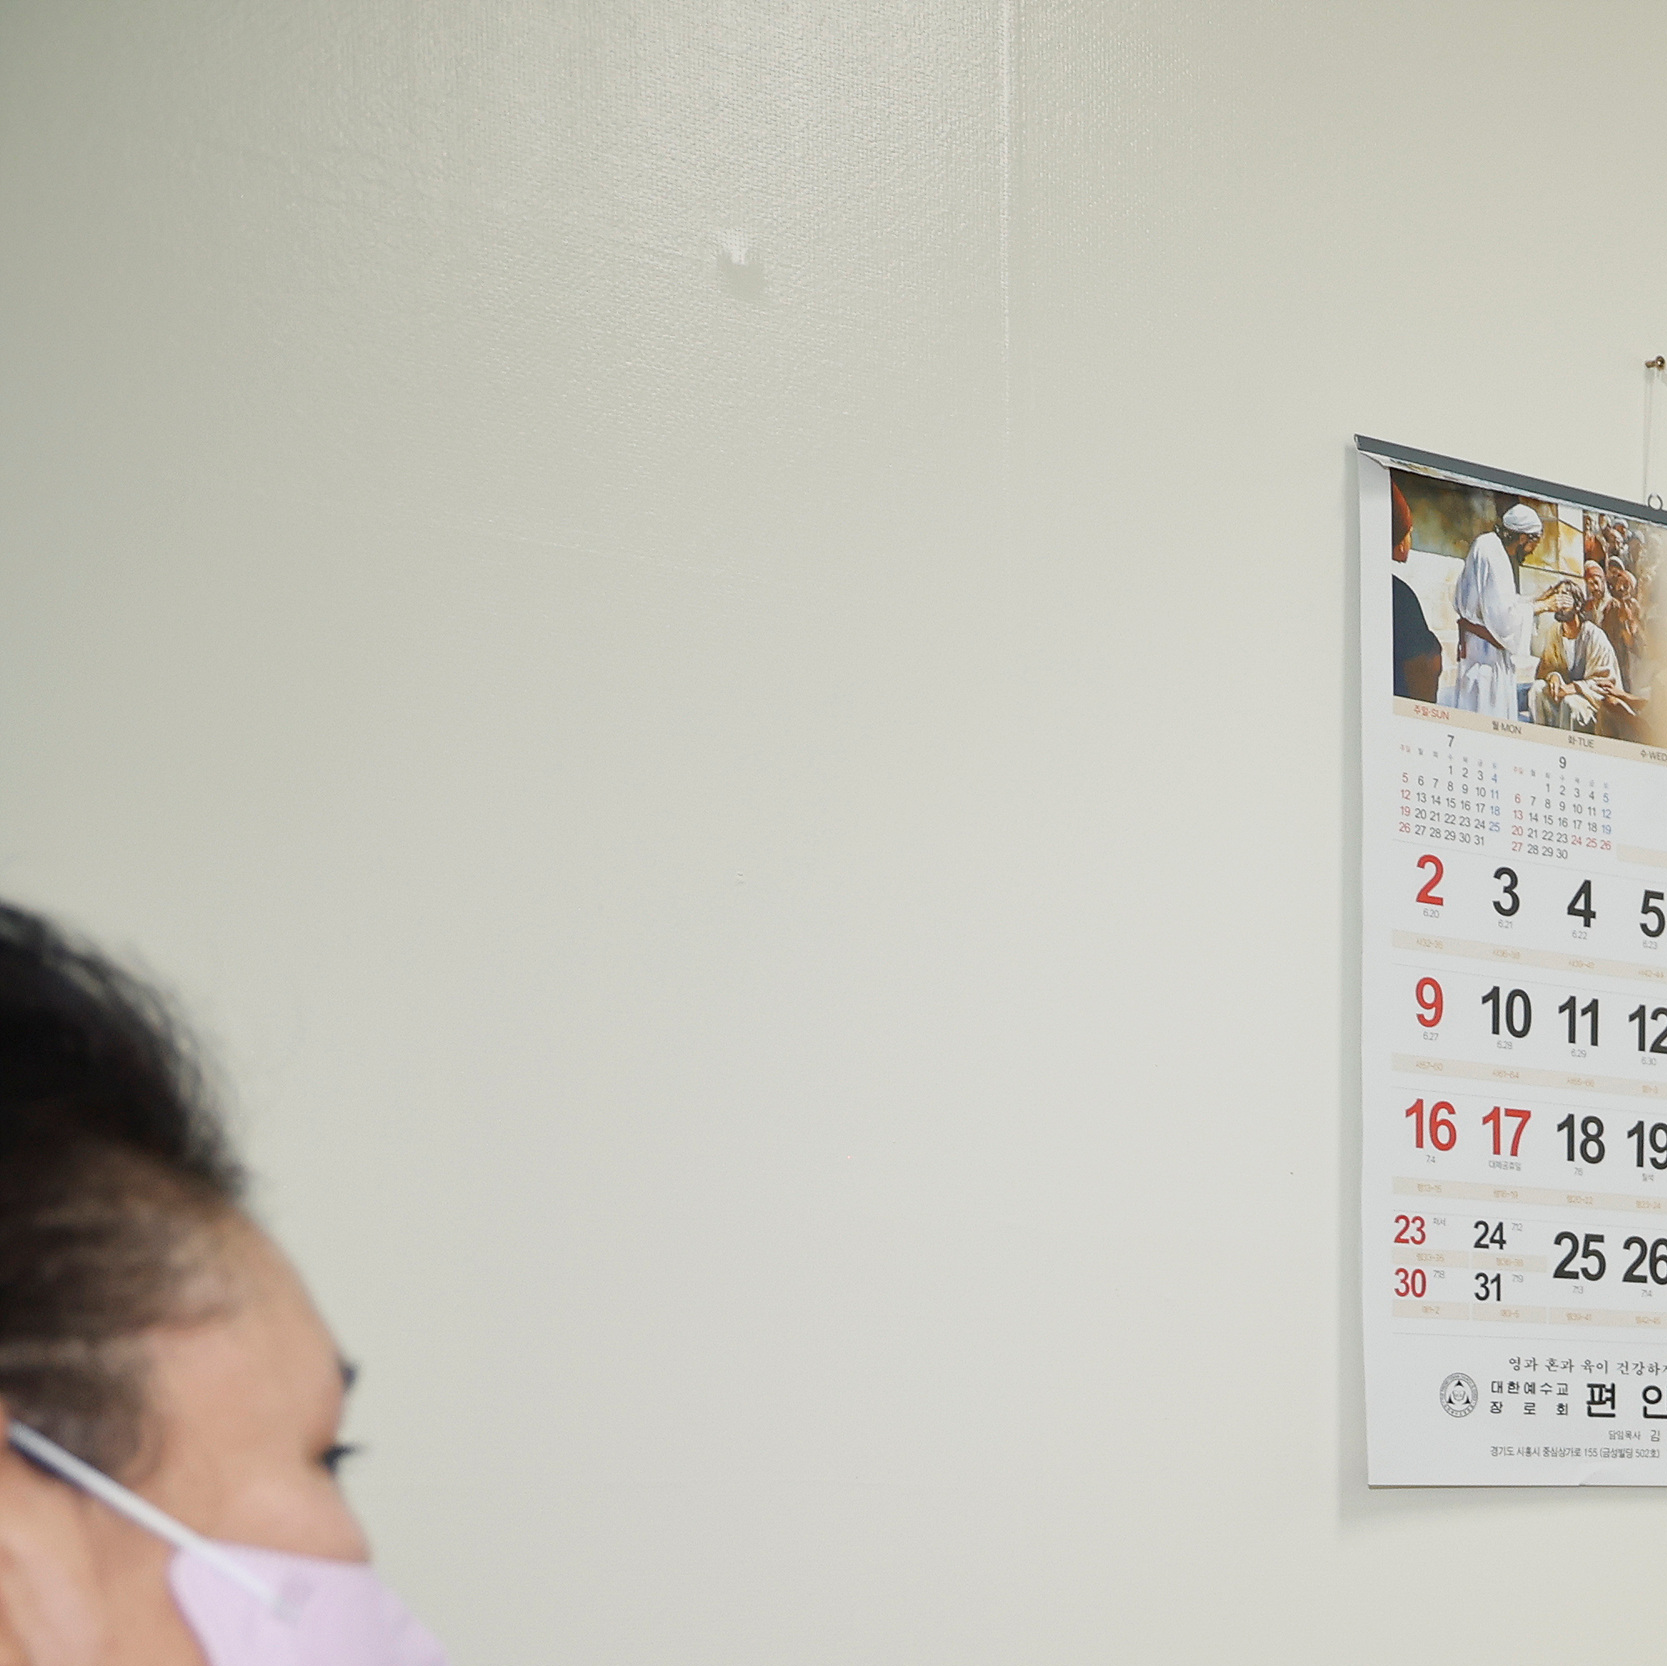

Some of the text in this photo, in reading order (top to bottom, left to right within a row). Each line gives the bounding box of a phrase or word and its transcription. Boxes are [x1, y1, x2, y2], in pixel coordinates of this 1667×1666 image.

[1447, 734, 1455, 748] 7
[1558, 756, 1567, 769] 9
[1400, 788, 1501, 817] 12 13 14 15 16 17 18
[1475, 786, 1487, 798] 10
[1490, 788, 1499, 800] 11
[1399, 805, 1501, 833] 19 20 21 22 23 24 25
[1512, 809, 1612, 835] 13 14 15 16 17 18 19
[1572, 803, 1583, 815] 10
[1587, 806, 1597, 817] 11
[1601, 808, 1612, 820] 12
[1398, 821, 1485, 846] 26 27 28 29 30 31
[1511, 824, 1612, 851] 20 21 22 23 24 25 26
[1511, 840, 1569, 860] 27 28 29 30
[1415, 854, 1444, 907] 2
[1492, 866, 1521, 917] 3
[1566, 879, 1597, 929] 4
[1639, 889, 1666, 938] 5
[1415, 976, 1444, 1028] 9
[1481, 985, 1532, 1039] 10
[1558, 995, 1599, 1047] 11
[1405, 1098, 1457, 1152] 16
[1482, 1105, 1532, 1157] 17
[1556, 1113, 1606, 1165] 18
[1393, 1214, 1427, 1246] 23
[1473, 1220, 1507, 1251] 24
[1552, 1231, 1607, 1282] 25
[1394, 1267, 1501, 1302] 30 31
[1508, 1356, 1539, 1372] 영과
[1544, 1357, 1575, 1374] 혼과
[1580, 1358, 1609, 1375] 육이
[1490, 1380, 1569, 1396] 대한예수교
[1608, 1429, 1642, 1441] 담임목사
[1490, 1446, 1515, 1457] 경기도
[1584, 1448, 1598, 1457] 155
